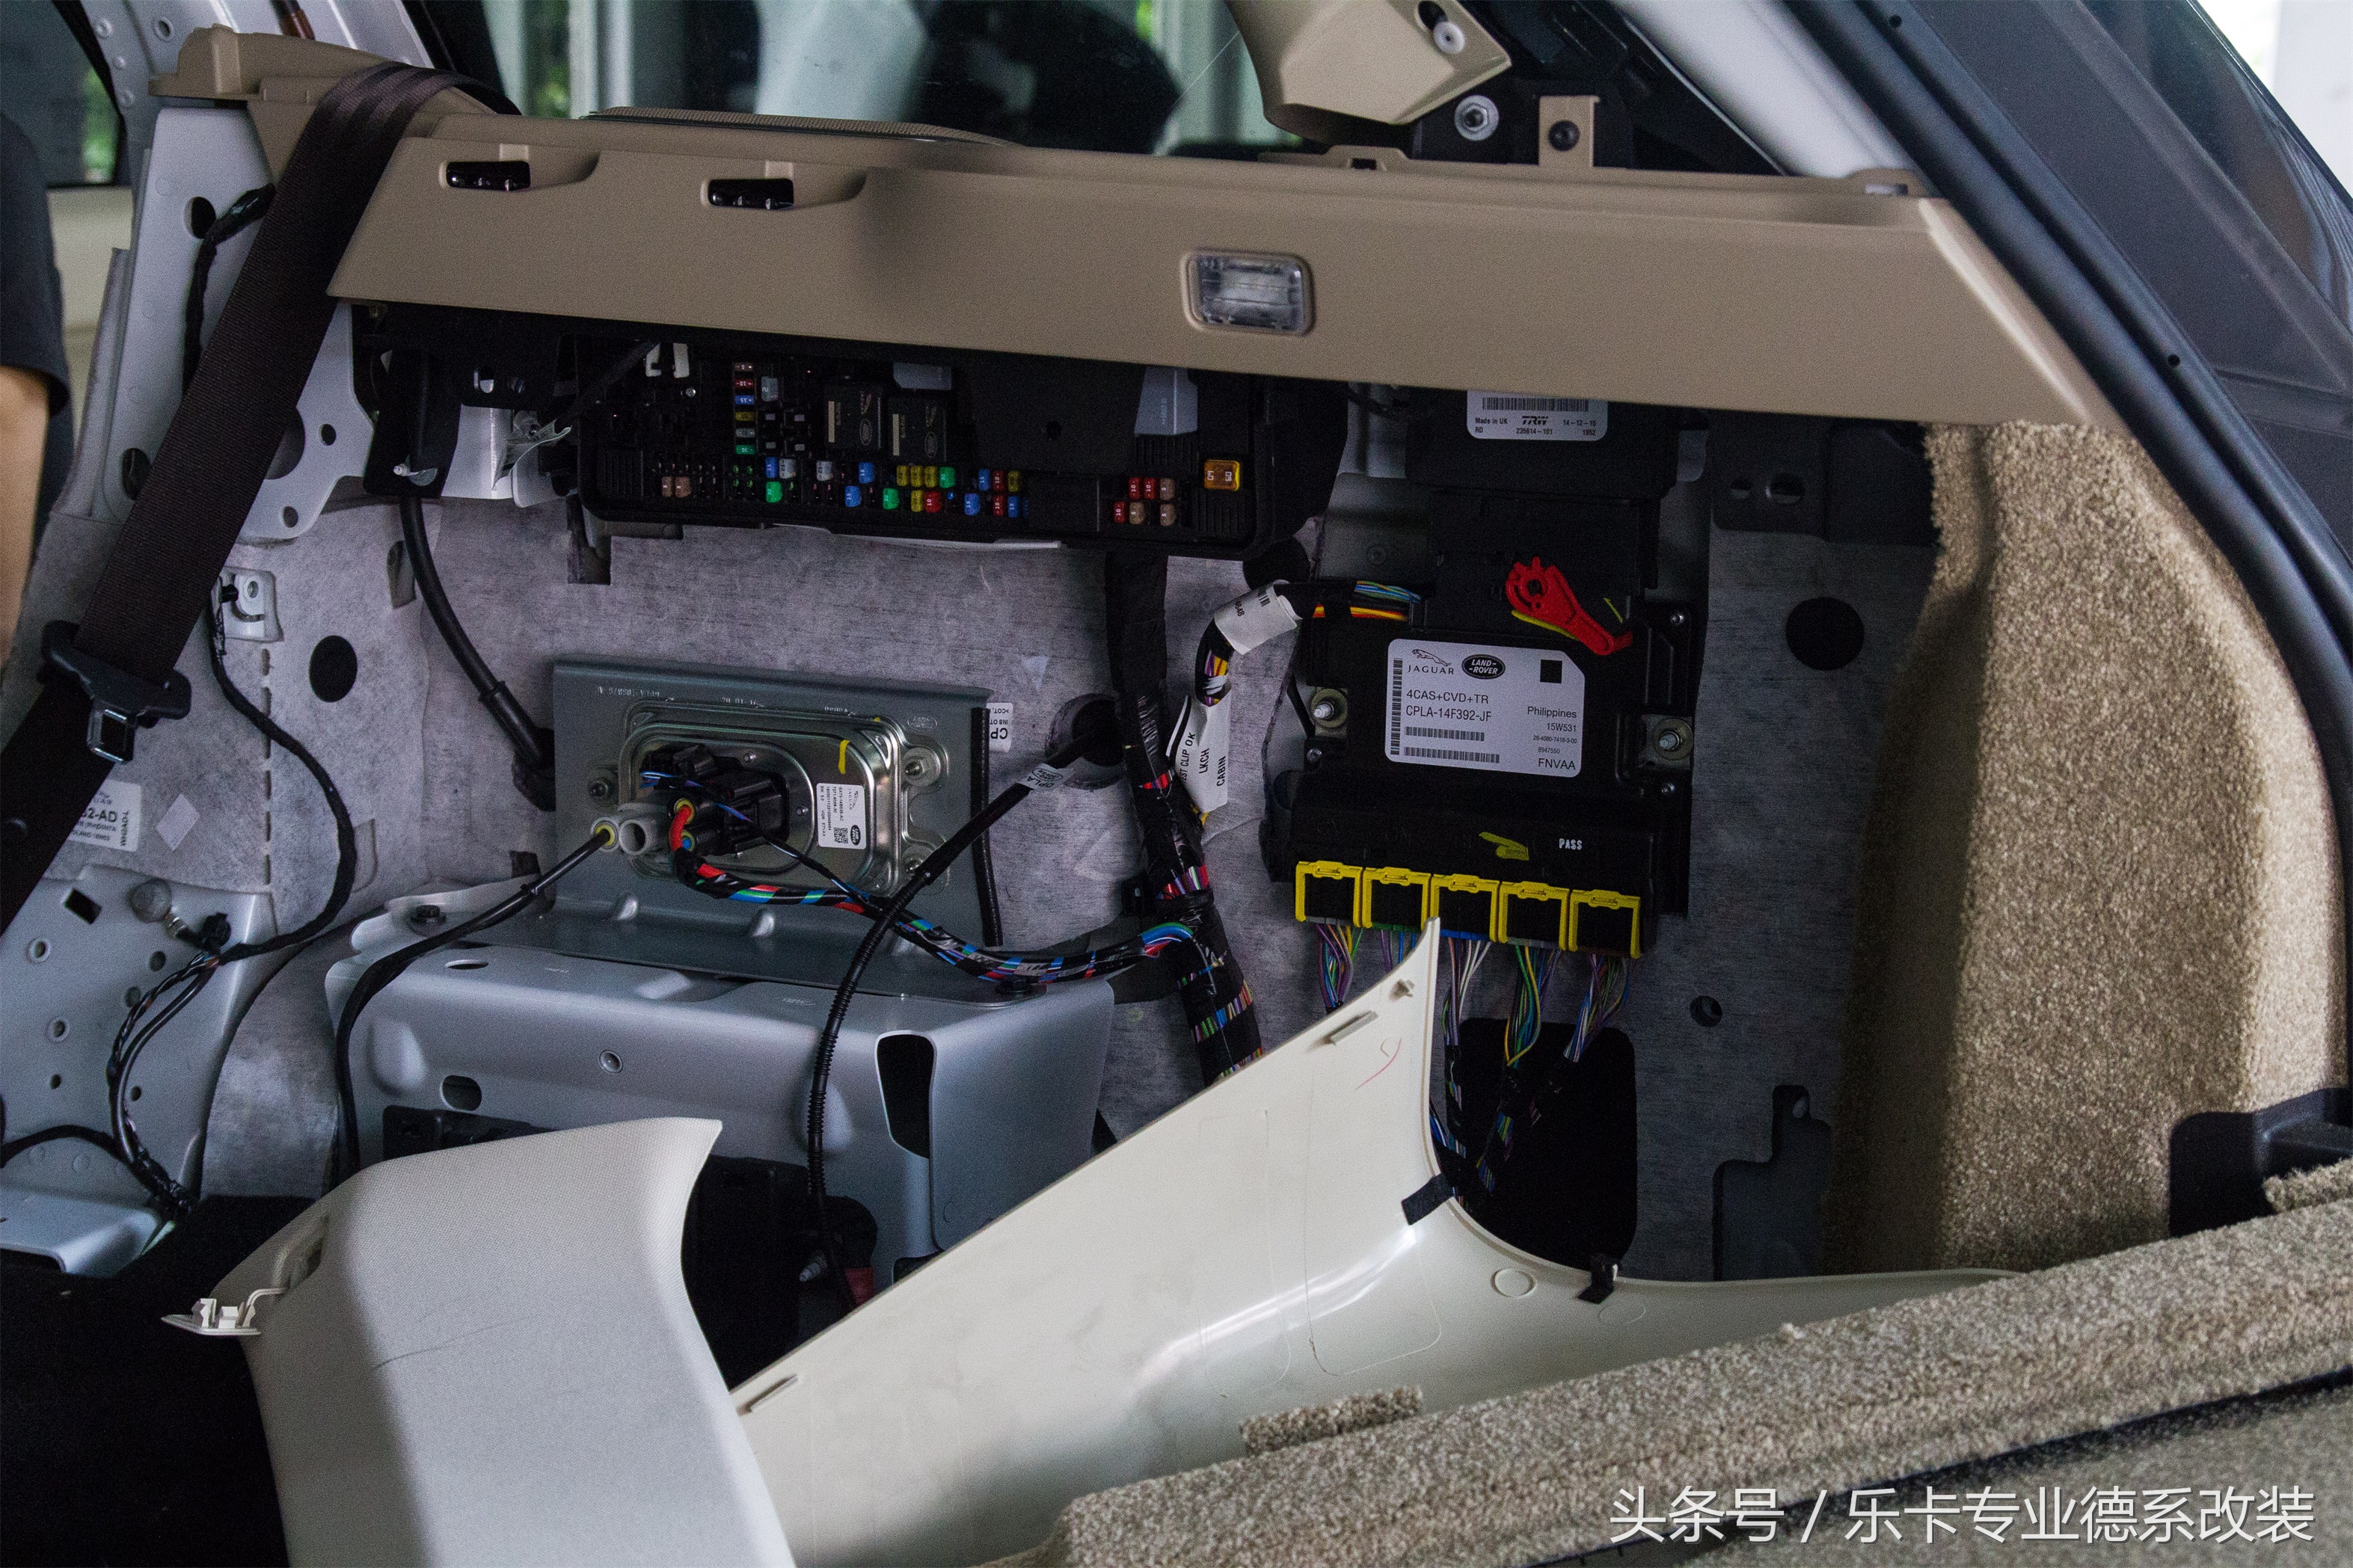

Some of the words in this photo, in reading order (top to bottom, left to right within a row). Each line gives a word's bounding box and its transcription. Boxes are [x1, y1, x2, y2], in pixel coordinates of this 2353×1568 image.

[1521, 416, 1548, 425] TRW
[1146, 484, 1151, 492] 10
[1408, 665, 1454, 675] JAGUAR
[1406, 689, 1489, 704] 4CAS+CVD+TR
[1406, 705, 1492, 722] CPLA-14F392-JF
[1527, 706, 1577, 719] Philippines
[1546, 722, 1577, 733] 15W531
[1180, 749, 1190, 767] CLIP
[1185, 732, 1196, 747] OK
[1199, 748, 1210, 774] LKCH
[1538, 758, 1576, 770] FNVAA
[1216, 756, 1226, 787] CABIN
[1559, 838, 1582, 850] PASS
